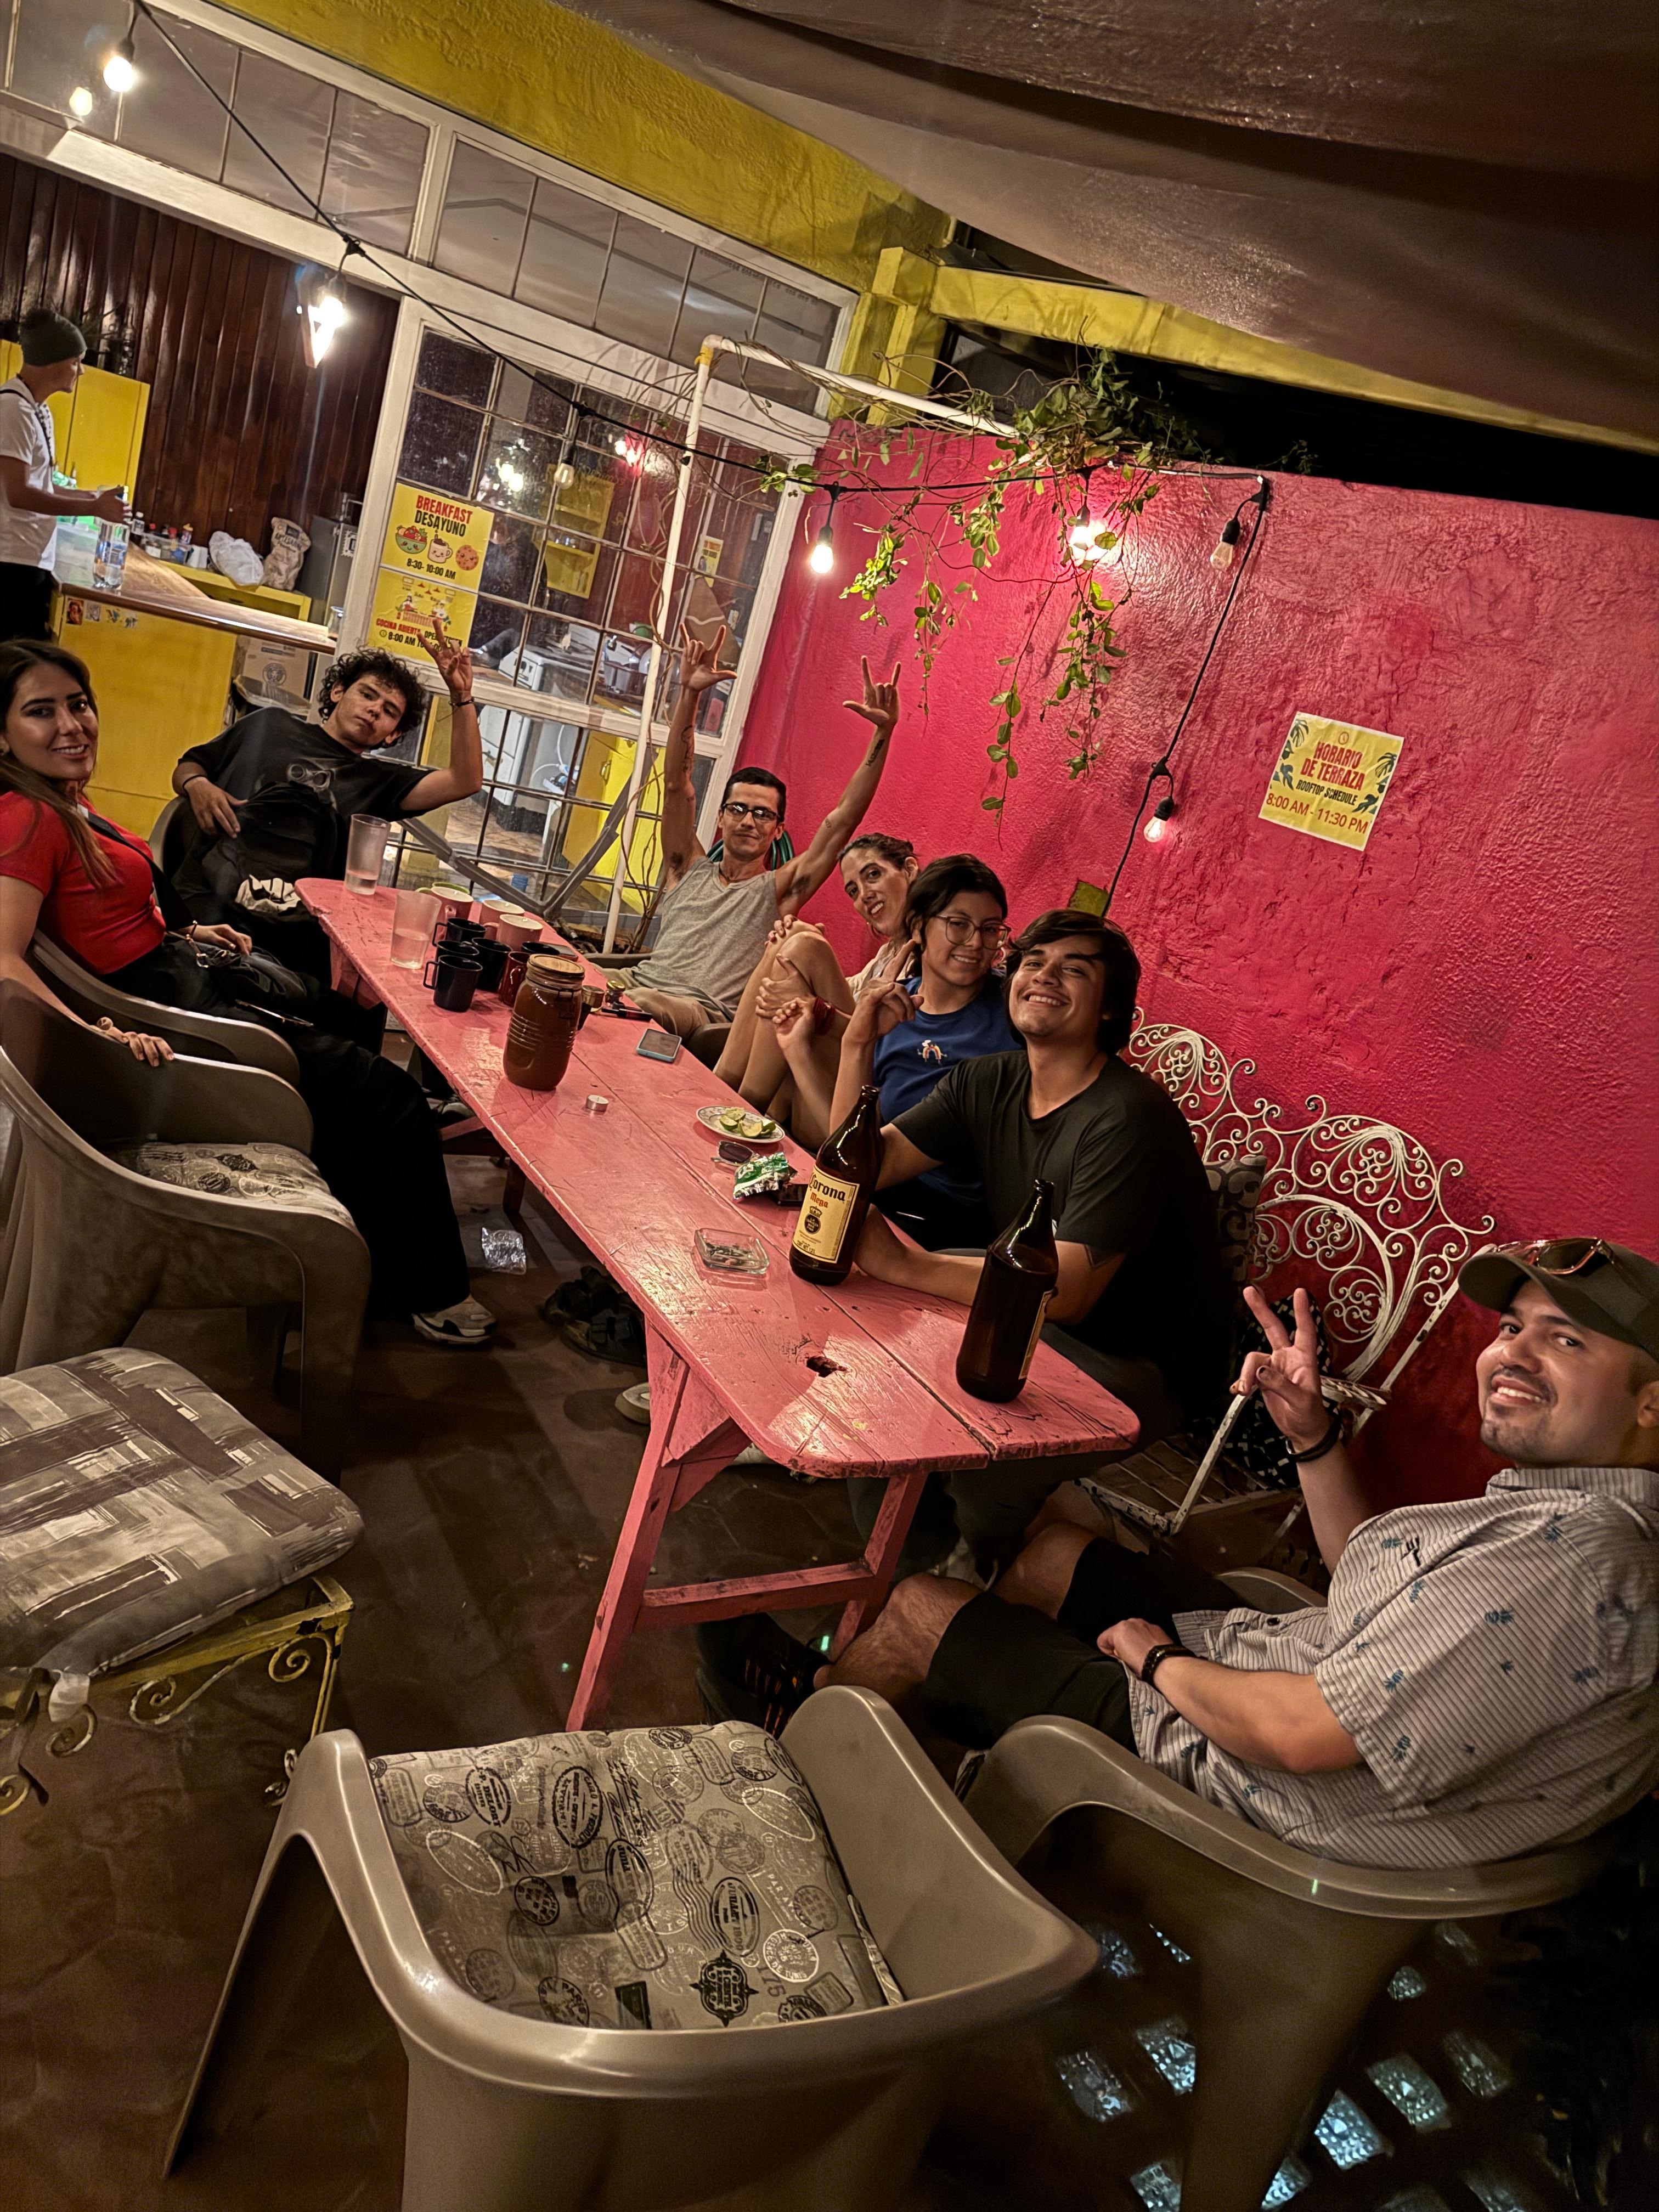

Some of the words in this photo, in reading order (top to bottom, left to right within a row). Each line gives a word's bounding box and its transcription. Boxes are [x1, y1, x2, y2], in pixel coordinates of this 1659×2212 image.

[416, 495, 473, 524] BREAKFAST
[414, 510, 466, 537] DESAYUNO
[426, 563, 444, 576] 10:00
[444, 569, 456, 579] AM
[376, 618, 397, 630] COCINA
[424, 631, 437, 640] OPE
[388, 632, 403, 642] 8:00
[404, 636, 415, 646] AM
[1313, 741, 1363, 769] HORARIO
[1300, 758, 1318, 777] DE
[1317, 762, 1365, 791] TERRAZA
[1296, 779, 1325, 795] ROOFTOP
[1324, 787, 1358, 805] SCHEDULE
[1266, 793, 1289, 809] 8:00
[1289, 800, 1310, 816] AM
[1317, 808, 1347, 827] 11:30
[1348, 817, 1369, 834] PM
[809, 1172, 846, 1201] Corona
[810, 1192, 828, 1208] Mega
[483, 1785, 501, 1827] DELORT
[768, 1874, 783, 1892] PAR
